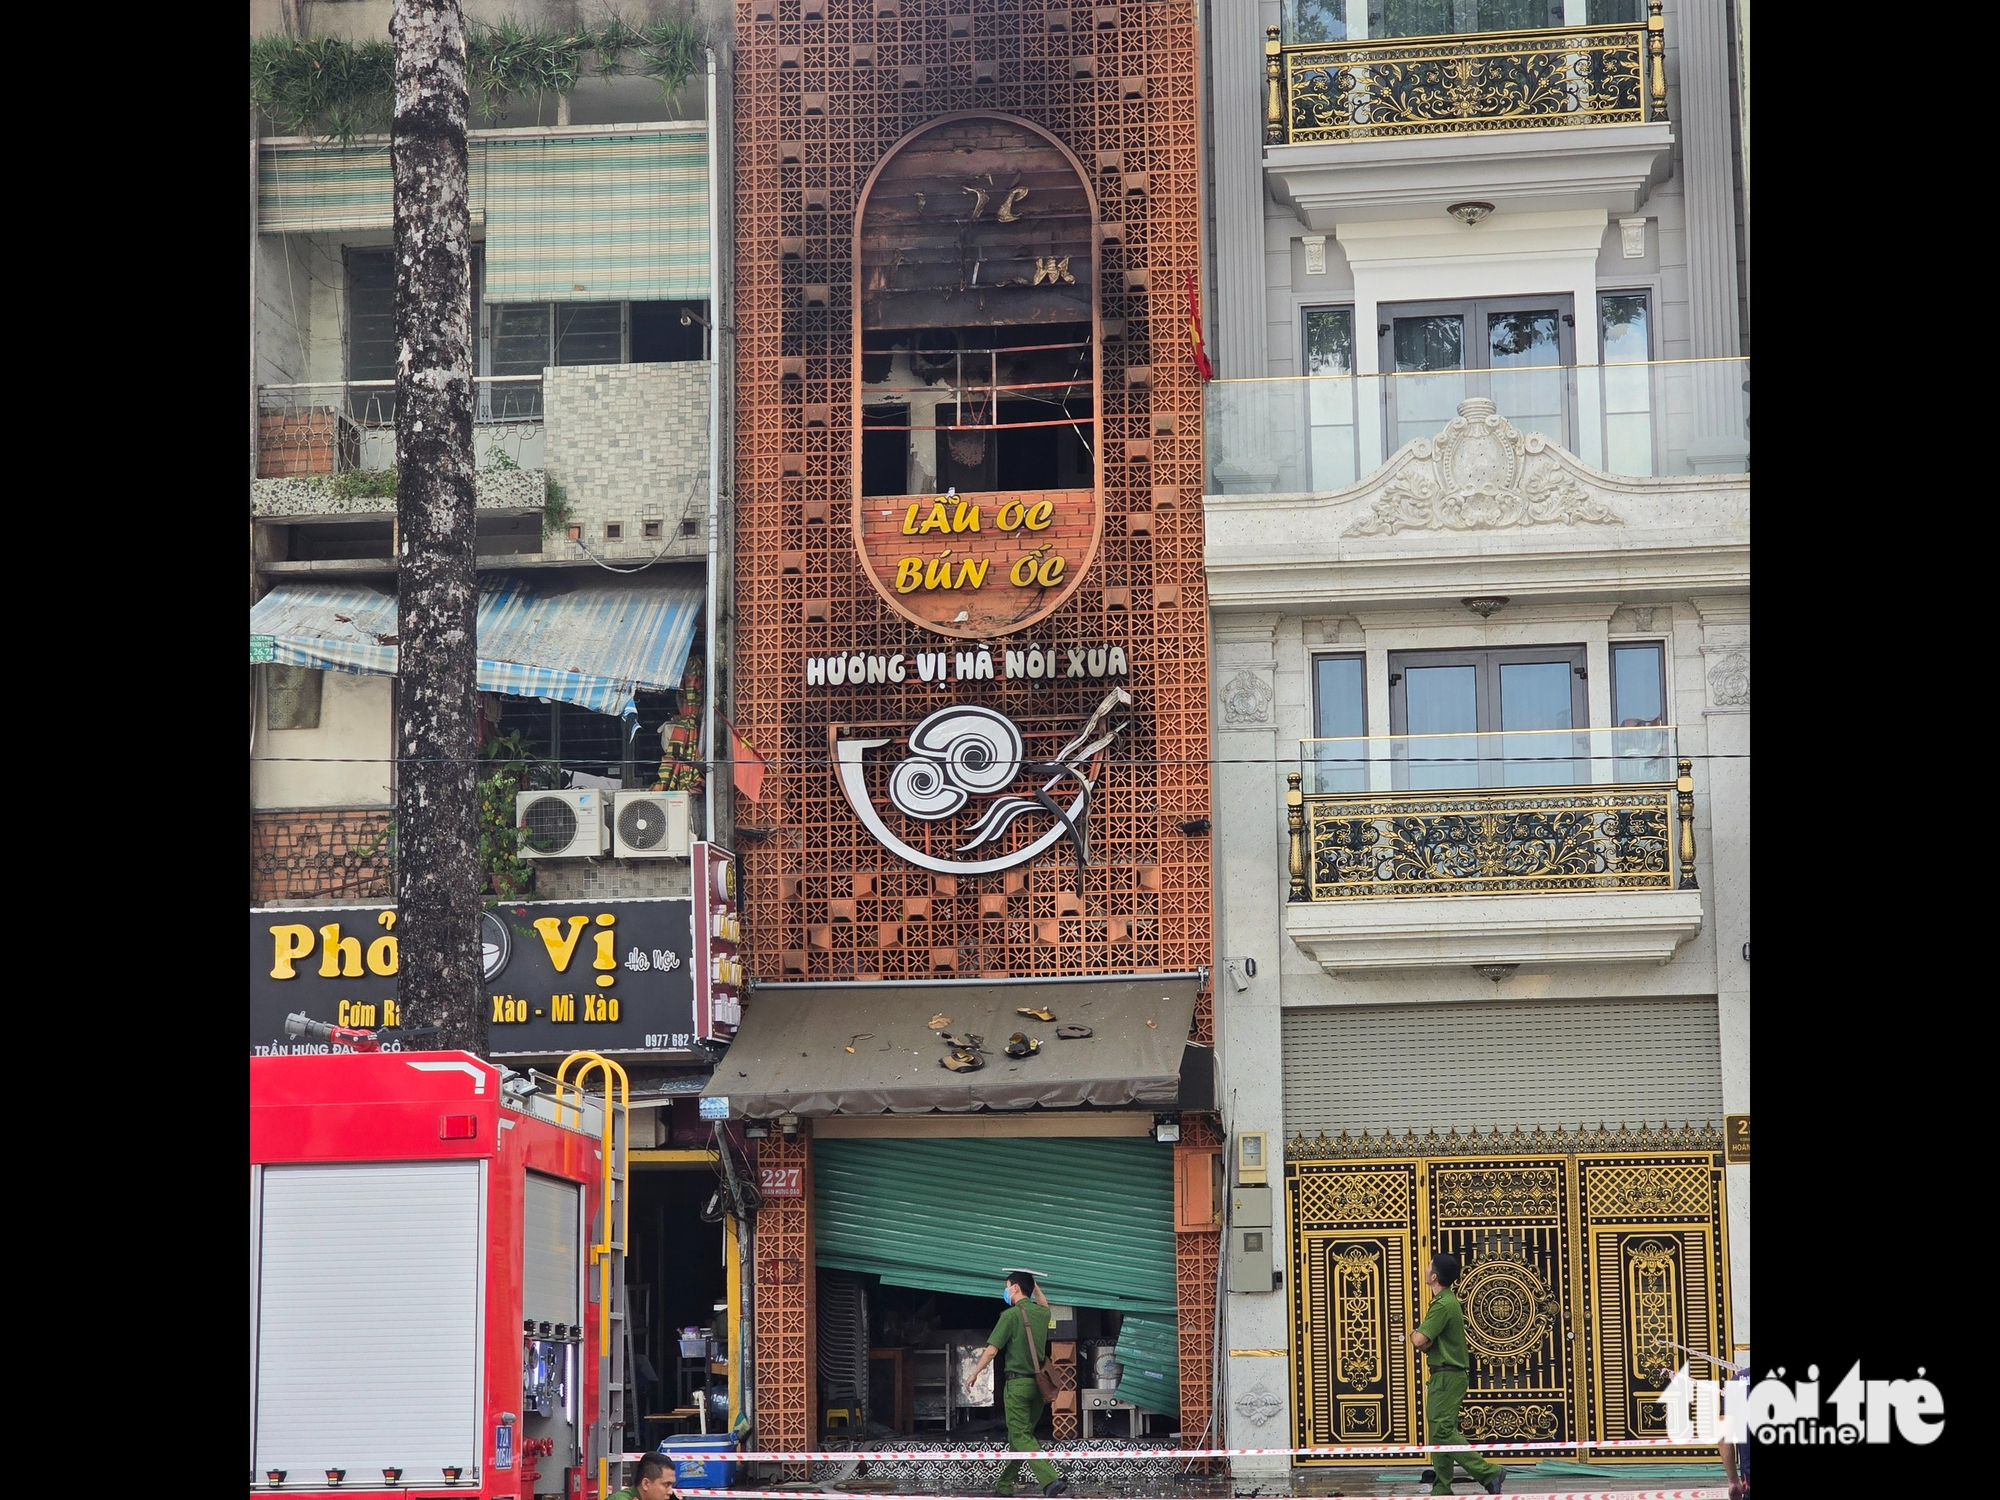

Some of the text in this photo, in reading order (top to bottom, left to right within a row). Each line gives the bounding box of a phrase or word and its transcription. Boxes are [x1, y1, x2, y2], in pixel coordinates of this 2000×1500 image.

[895, 543, 1066, 594] BÚN ỐC
[807, 651, 906, 686] HƯƠNG
[917, 652, 947, 689] VỊ
[955, 643, 994, 680] HÀ
[1066, 643, 1128, 678] XƯA
[533, 913, 617, 987] Vị
[624, 947, 680, 972] Hà Nội
[338, 999, 375, 1027] Cơm
[492, 994, 528, 1022] Xào
[551, 993, 575, 1022] Mì
[584, 993, 619, 1022] Xào
[254, 1039, 289, 1056] TRẦN
[292, 1043, 329, 1055] HƯNG
[645, 1033, 669, 1047] 0977
[672, 1033, 689, 1047] 682
[761, 1169, 800, 1187] 227
